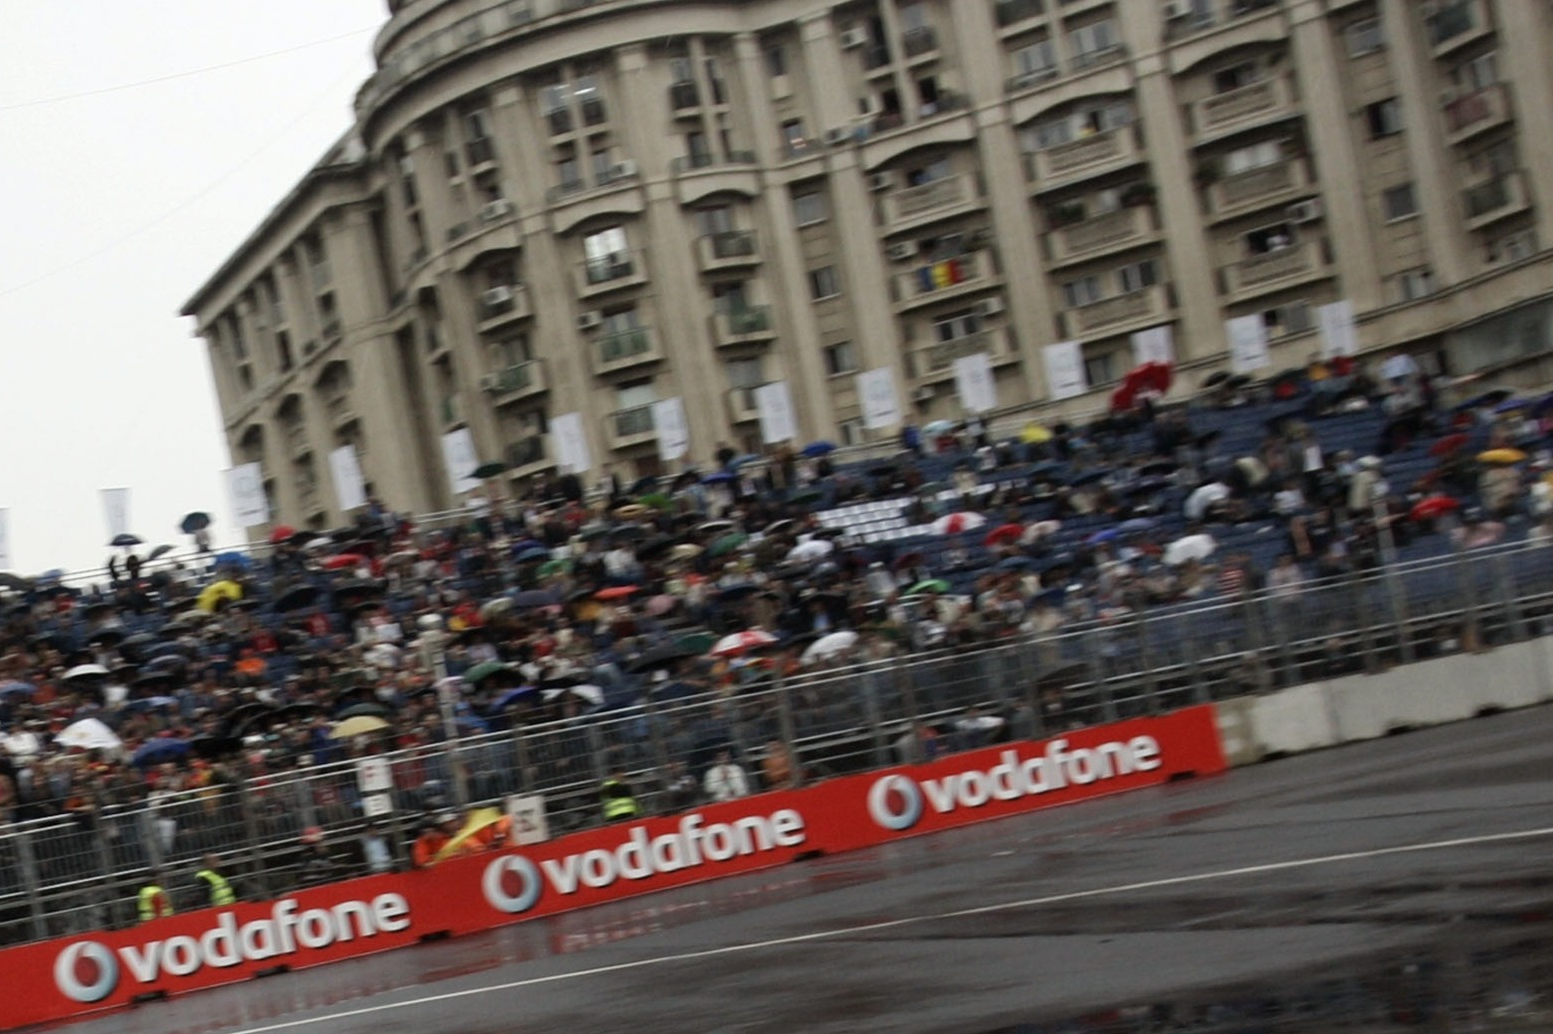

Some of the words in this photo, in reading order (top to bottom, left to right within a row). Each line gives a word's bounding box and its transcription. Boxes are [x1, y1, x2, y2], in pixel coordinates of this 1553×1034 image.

[921, 735, 1161, 813] vodafone
[542, 808, 806, 894] vodafone
[120, 892, 410, 982] vodafone
